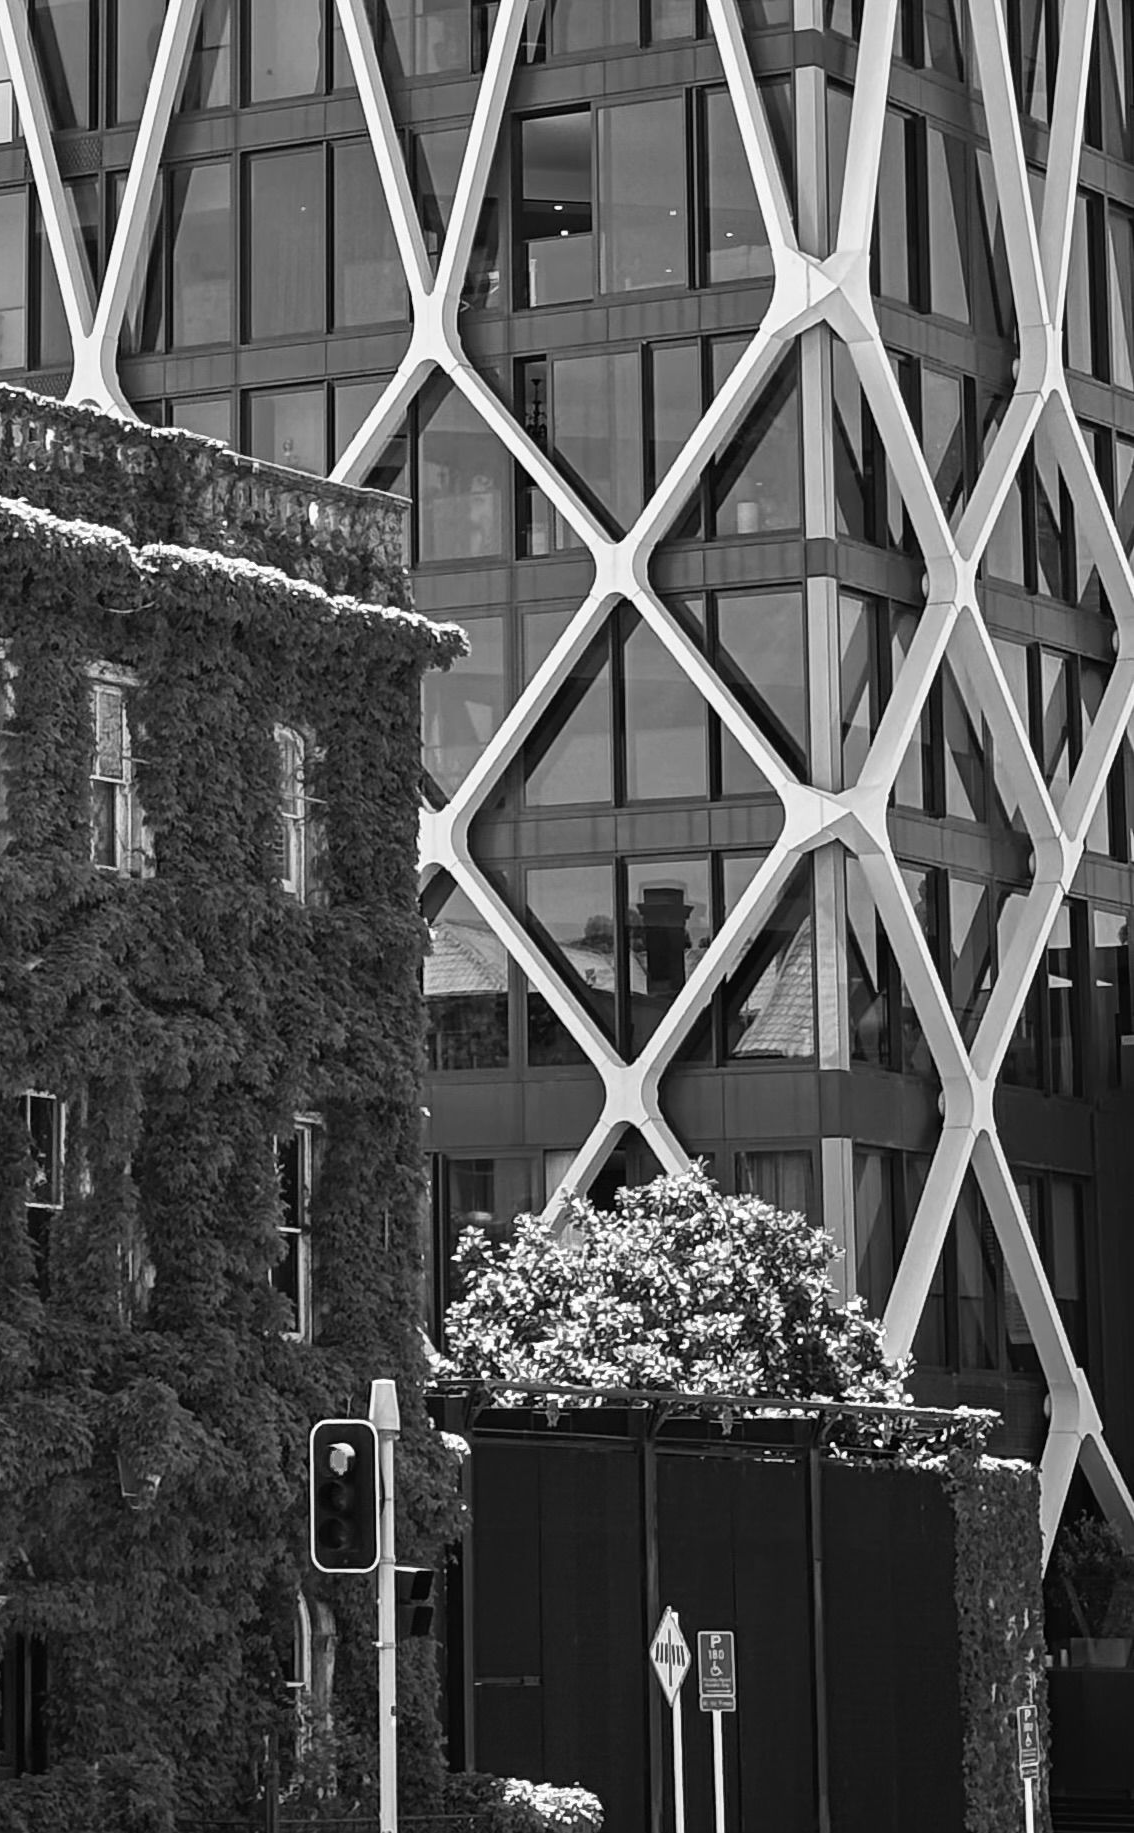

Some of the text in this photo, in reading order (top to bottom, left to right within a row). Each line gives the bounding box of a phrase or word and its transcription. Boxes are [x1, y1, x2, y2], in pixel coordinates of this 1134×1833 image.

[710, 1634, 722, 1649] P
[708, 1649, 725, 1660] 180
[1024, 1709, 1032, 1722] P
